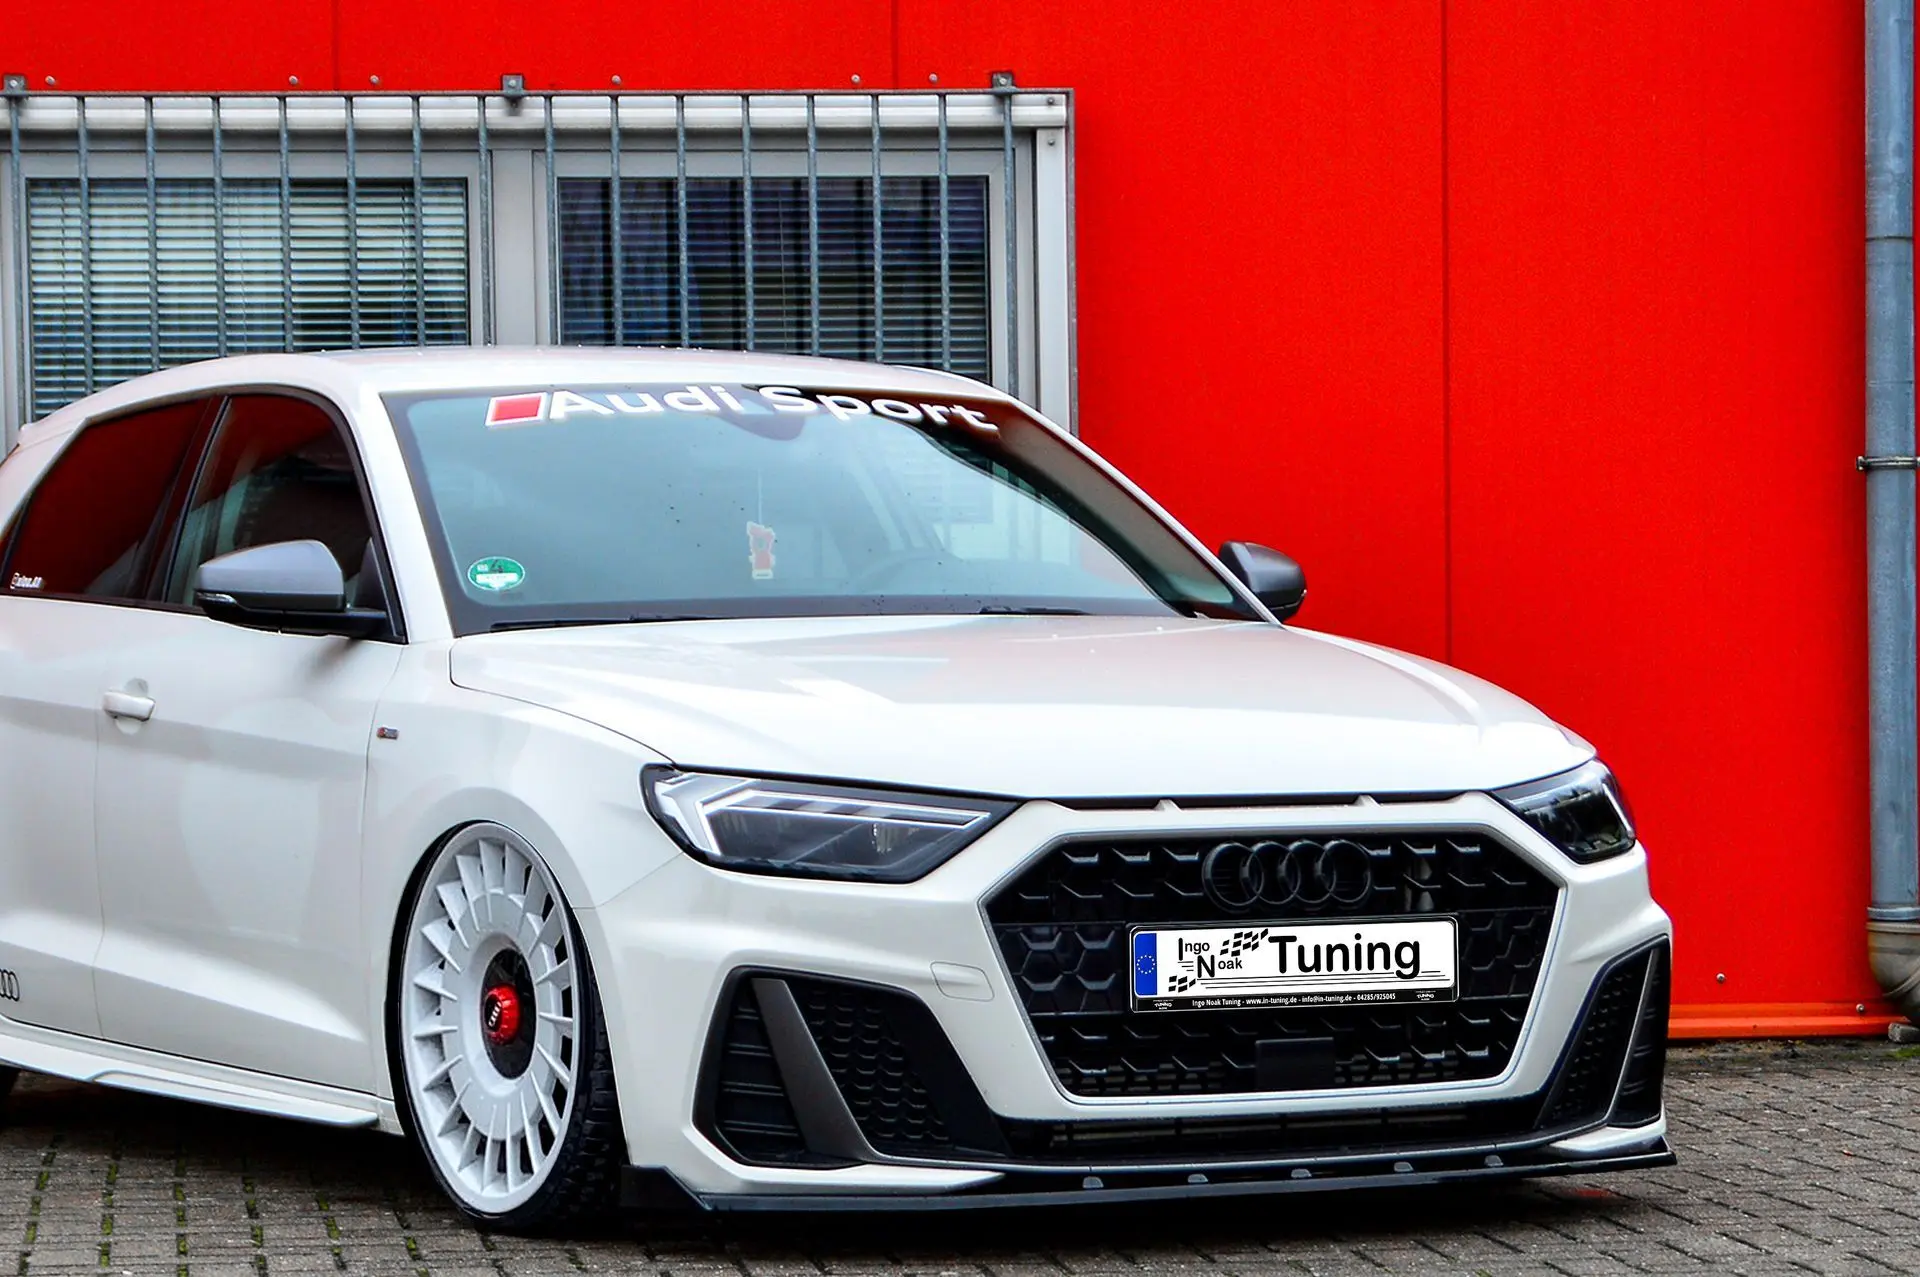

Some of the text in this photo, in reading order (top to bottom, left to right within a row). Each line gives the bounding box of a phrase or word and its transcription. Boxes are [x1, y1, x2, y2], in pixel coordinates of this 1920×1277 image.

[549, 386, 999, 432] Audi Sport
[1178, 938, 1211, 962] Ingo
[1268, 933, 1421, 980] Tuning
[1197, 954, 1243, 979] Noak
[1192, 999, 1205, 1008] Ingo
[1206, 999, 1221, 1007] Noak
[1222, 998, 1241, 1007] Tuning
[1246, 995, 1297, 1006] www.in-tuning.de
[1302, 994, 1352, 1004] info@in-tuning.de
